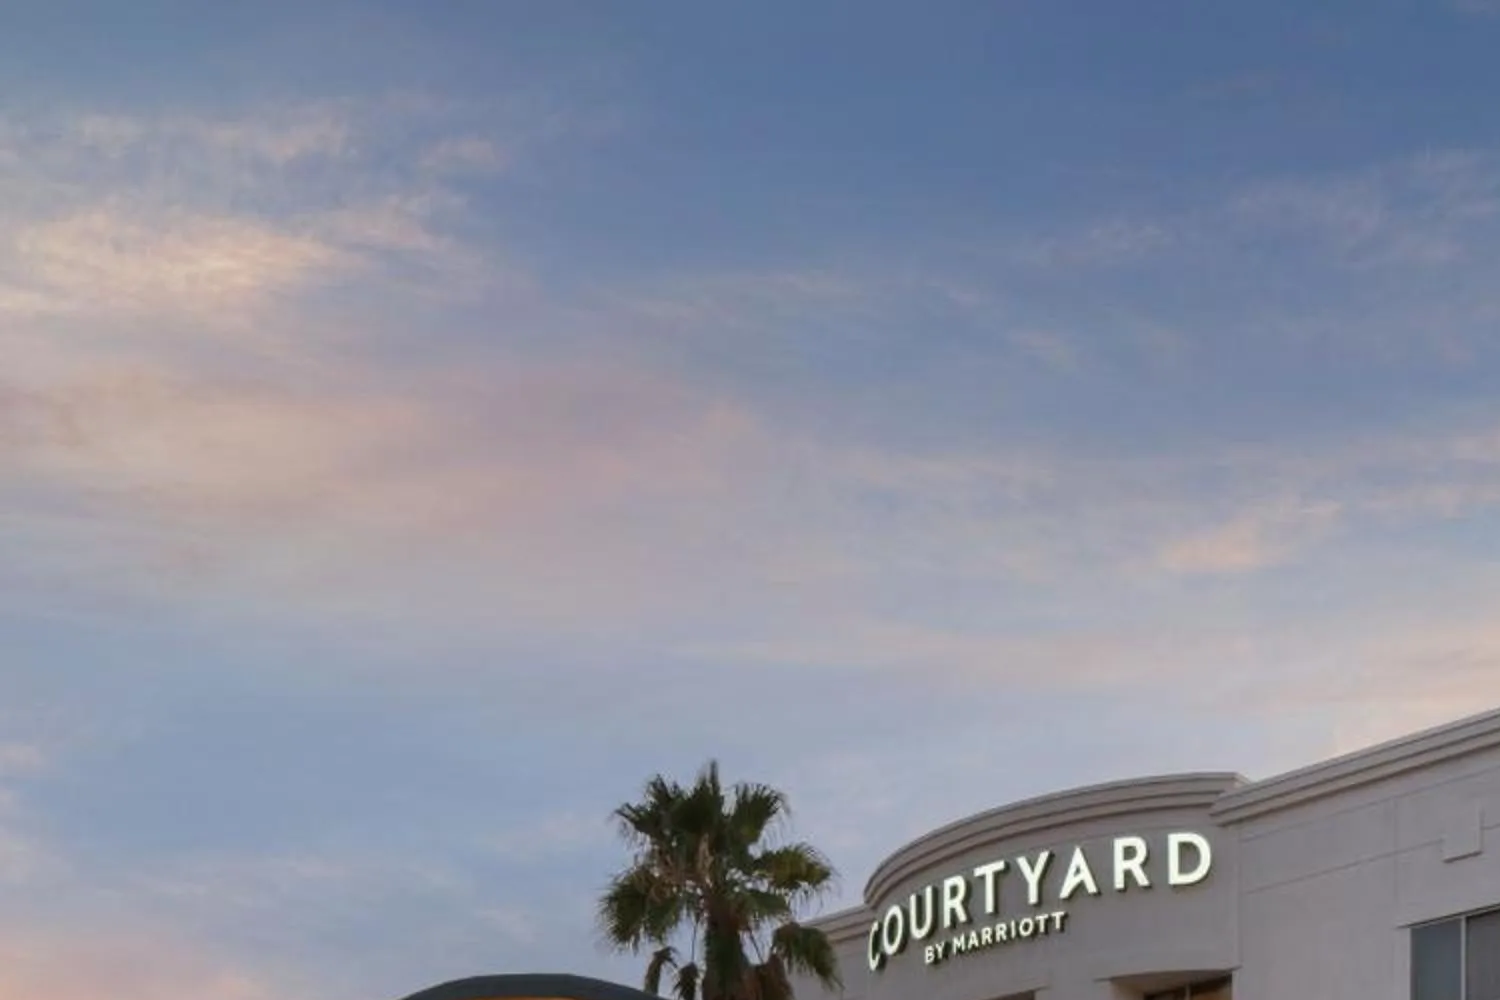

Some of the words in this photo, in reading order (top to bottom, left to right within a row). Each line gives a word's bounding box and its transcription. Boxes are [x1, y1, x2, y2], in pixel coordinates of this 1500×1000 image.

[867, 831, 1213, 971] COURTYARD
[924, 941, 947, 965] BY
[952, 910, 1066, 955] MARRIOTT
